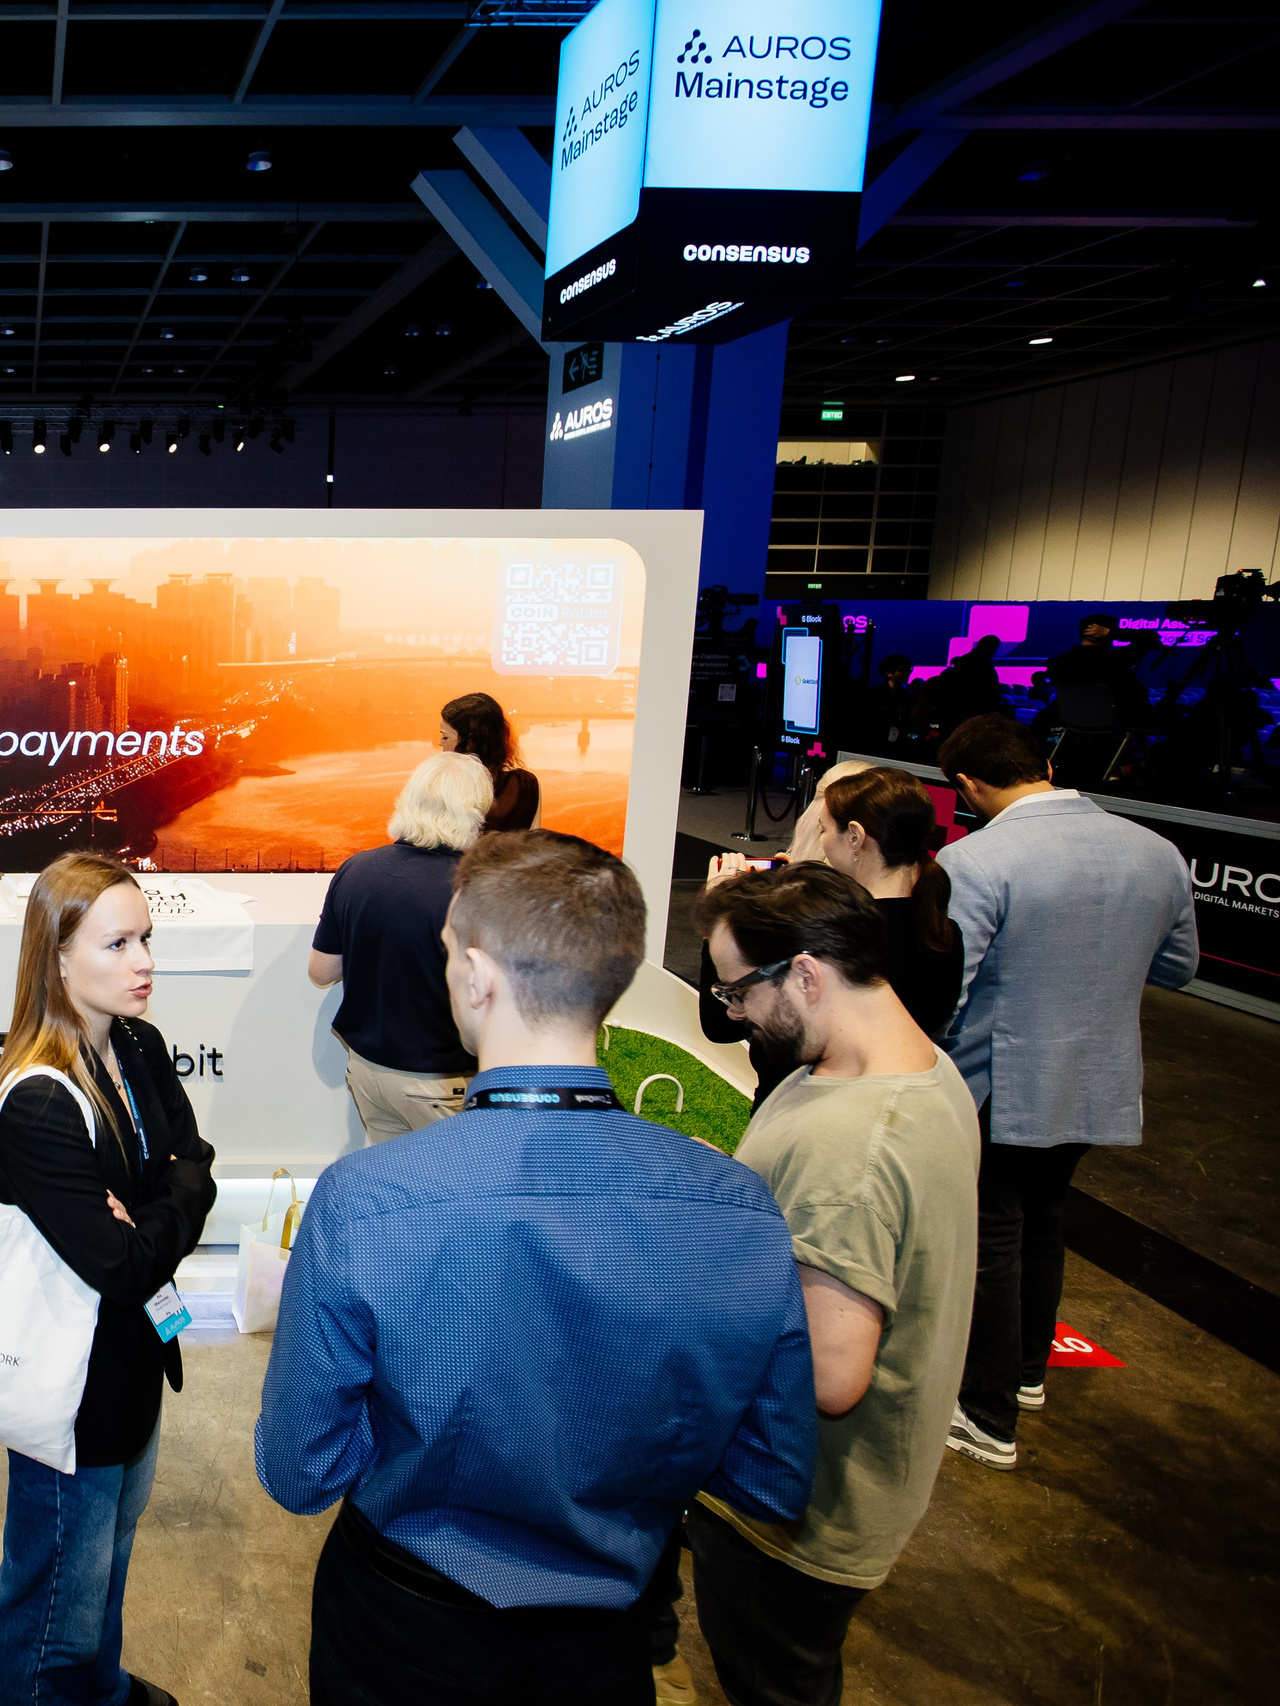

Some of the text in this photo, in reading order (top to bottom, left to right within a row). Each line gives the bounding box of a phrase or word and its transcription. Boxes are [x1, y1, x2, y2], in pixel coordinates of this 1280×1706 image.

[722, 35, 851, 61] AUROS
[581, 49, 640, 121] AUROS
[675, 71, 849, 109] Mainstage
[561, 90, 638, 171] Mainstage
[683, 244, 810, 264] CONSENSUS
[560, 258, 616, 305] CONSENSUS
[564, 398, 613, 432] AUROS
[511, 607, 554, 619] COIN
[806, 615, 822, 623] Block
[1119, 618, 1160, 630] Digital
[1194, 891, 1280, 919] DIGITAL MARKETS
[173, 1043, 224, 1077] bit
